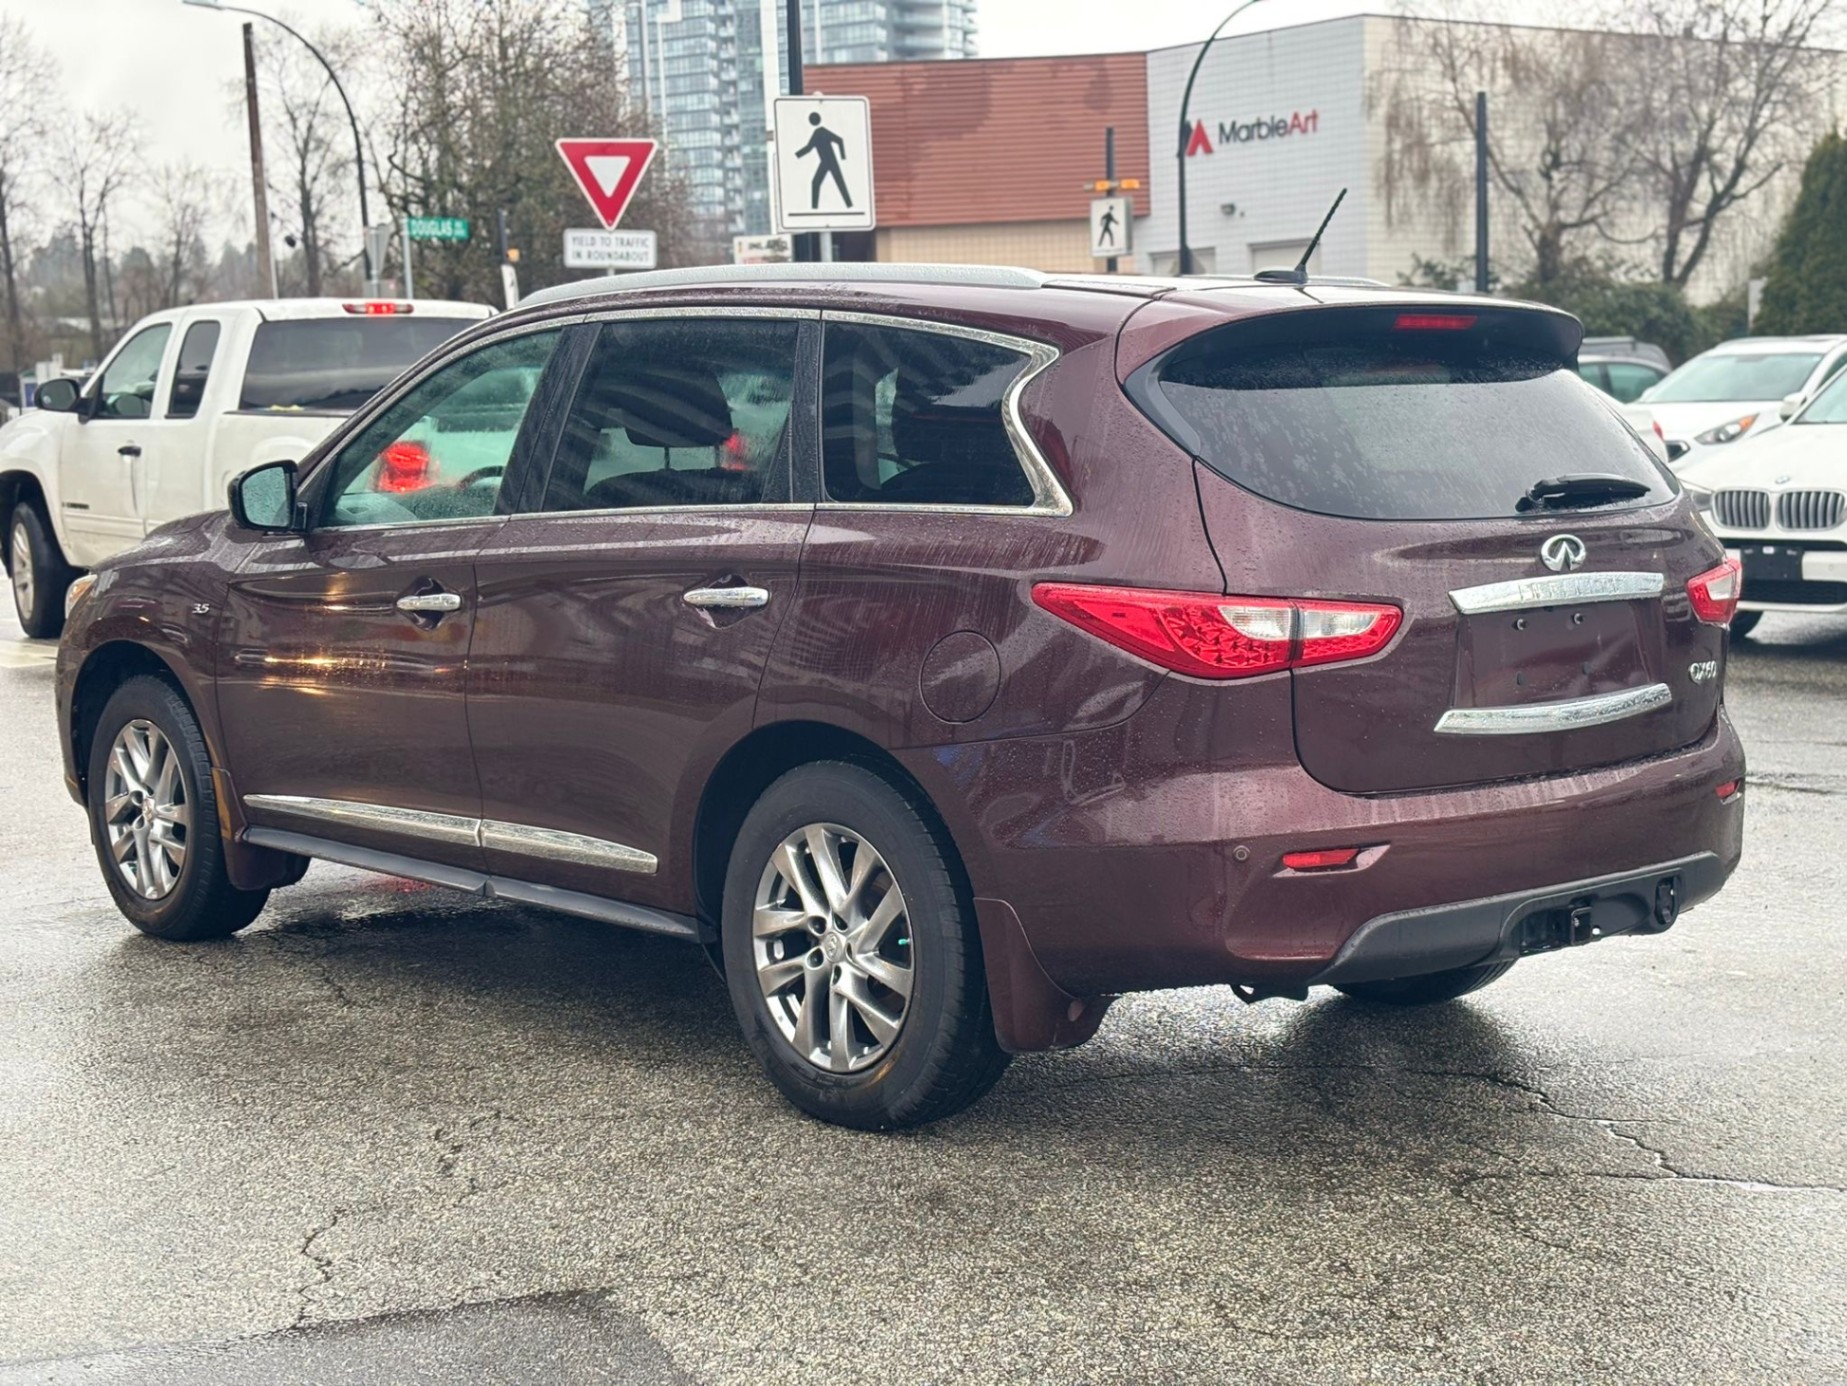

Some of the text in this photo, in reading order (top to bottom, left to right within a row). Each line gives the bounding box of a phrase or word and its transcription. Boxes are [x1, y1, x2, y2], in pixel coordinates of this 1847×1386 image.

[1218, 109, 1318, 145] MarbleArt
[572, 236, 650, 248] YIELD TO TRAFFIC
[572, 250, 650, 262] IN ROUNDABOUT
